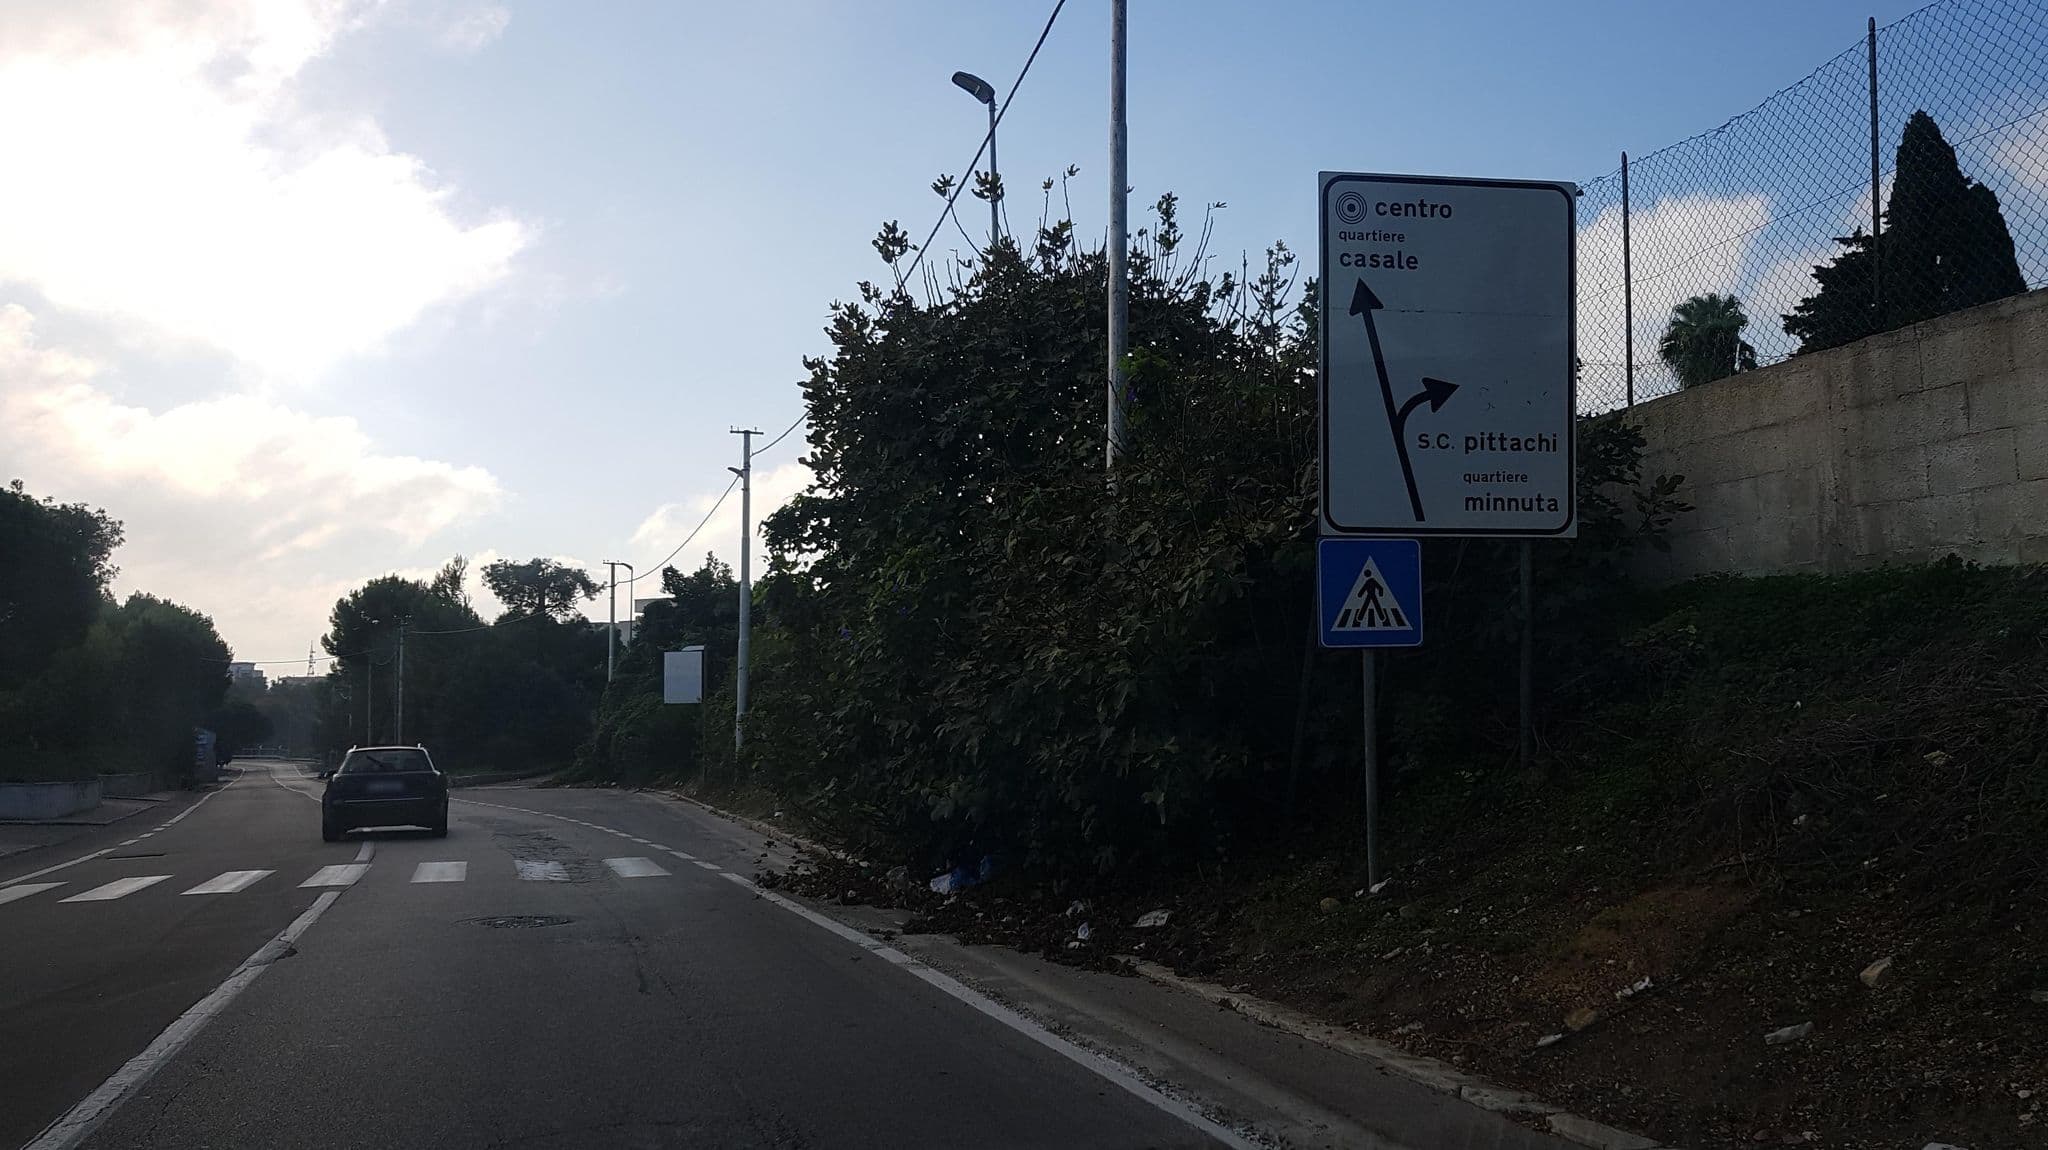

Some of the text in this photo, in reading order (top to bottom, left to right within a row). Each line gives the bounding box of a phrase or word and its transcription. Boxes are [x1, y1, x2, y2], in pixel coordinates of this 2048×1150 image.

[1375, 198, 1452, 219] centro
[1338, 229, 1405, 245] quartiere
[1340, 250, 1419, 270] casale
[1418, 431, 1557, 455] S.C. pittachi
[1463, 470, 1528, 486] quartiere
[1464, 492, 1559, 513] minnuta
